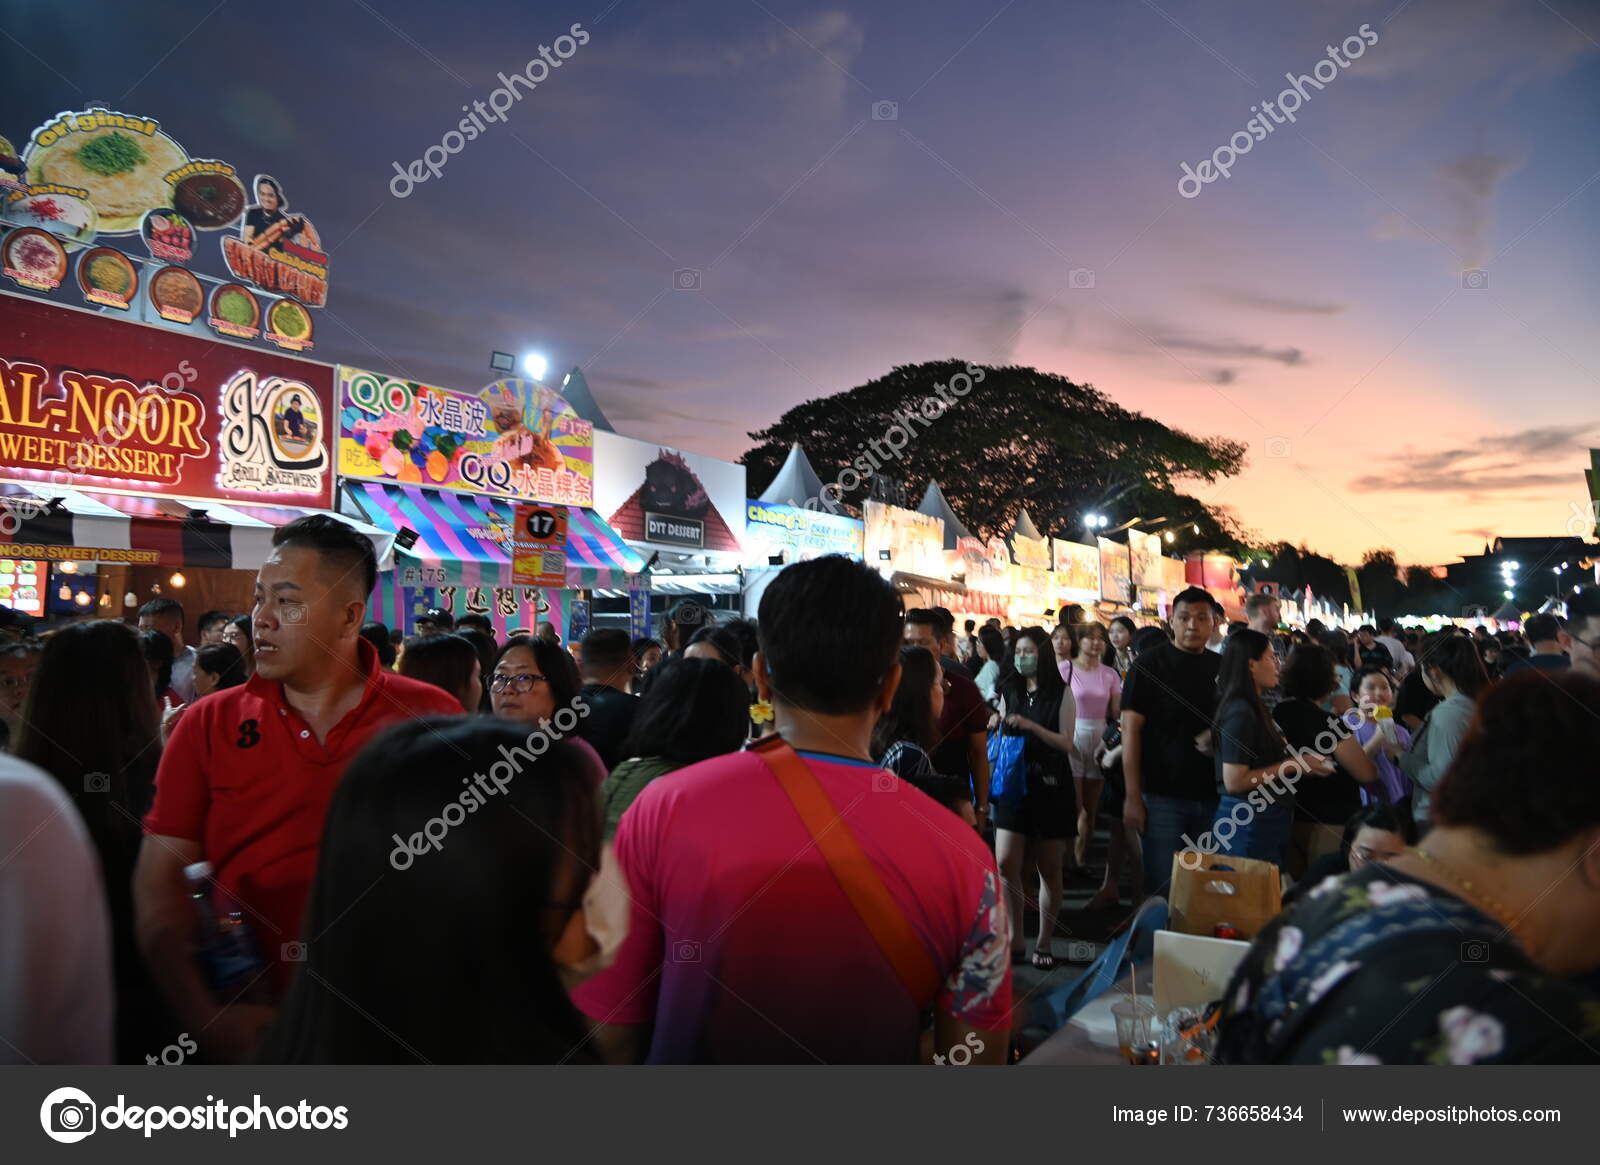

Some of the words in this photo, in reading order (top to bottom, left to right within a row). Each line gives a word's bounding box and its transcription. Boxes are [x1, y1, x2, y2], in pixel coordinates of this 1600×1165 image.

[419, 392, 485, 434] 水晶波
[75, 441, 175, 478] DESSERT
[461, 455, 511, 491] QQ
[529, 515, 555, 534] 17
[668, 523, 700, 540] DESSERT
[0, 545, 44, 558] NOOR
[48, 546, 98, 561] SWEET
[100, 548, 159, 563] DESSERT
[404, 567, 446, 583] #175
